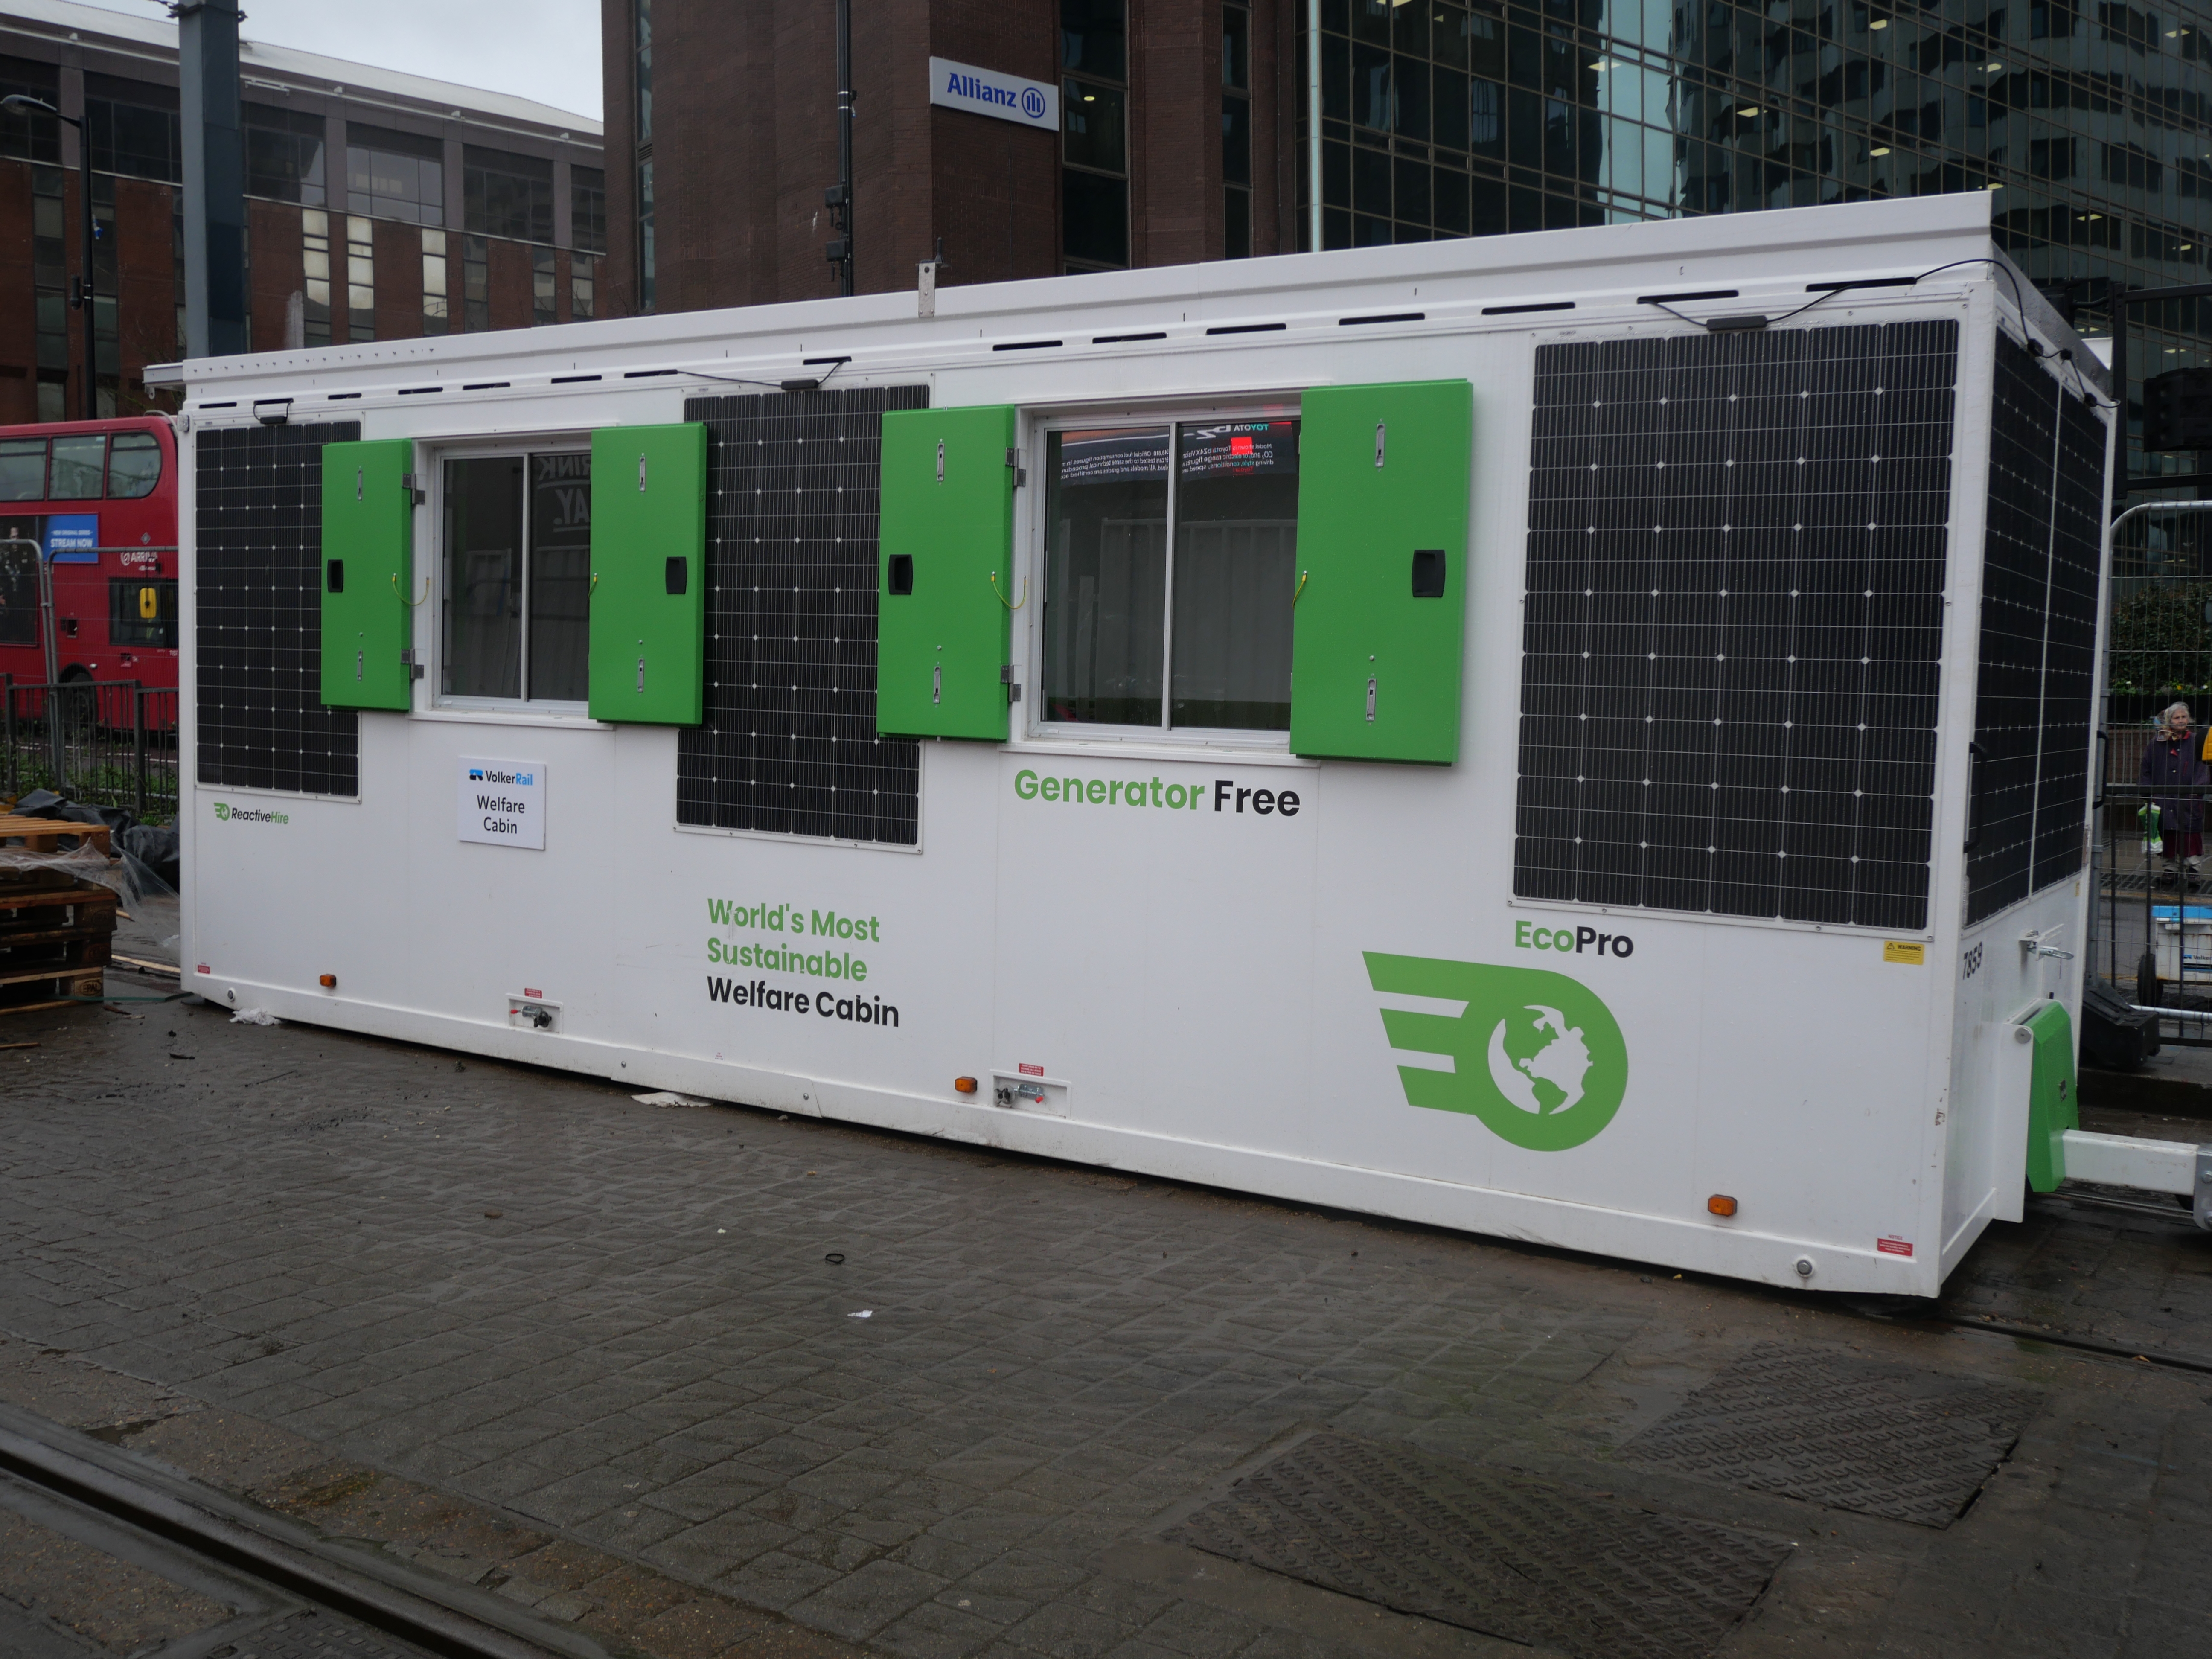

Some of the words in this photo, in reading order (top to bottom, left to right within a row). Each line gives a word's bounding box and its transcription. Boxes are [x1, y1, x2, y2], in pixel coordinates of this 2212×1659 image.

[947, 72, 1016, 108] Allianz
[50, 538, 76, 547] STREAM
[77, 538, 93, 548] NOW
[486, 770, 533, 786] VolkerRail
[1014, 769, 1205, 810] Generator
[1214, 780, 1301, 816] Free
[232, 807, 289, 824] ReactiveHire
[477, 794, 525, 814] Welfare
[483, 816, 518, 835] Cabin
[707, 898, 804, 934] World's
[811, 909, 880, 942] Most
[1515, 920, 1634, 958] EcoPro
[707, 937, 867, 981] Sustainable
[1963, 941, 1982, 980] 7859
[707, 976, 809, 1014] Welfare
[815, 991, 899, 1027] Cabin
